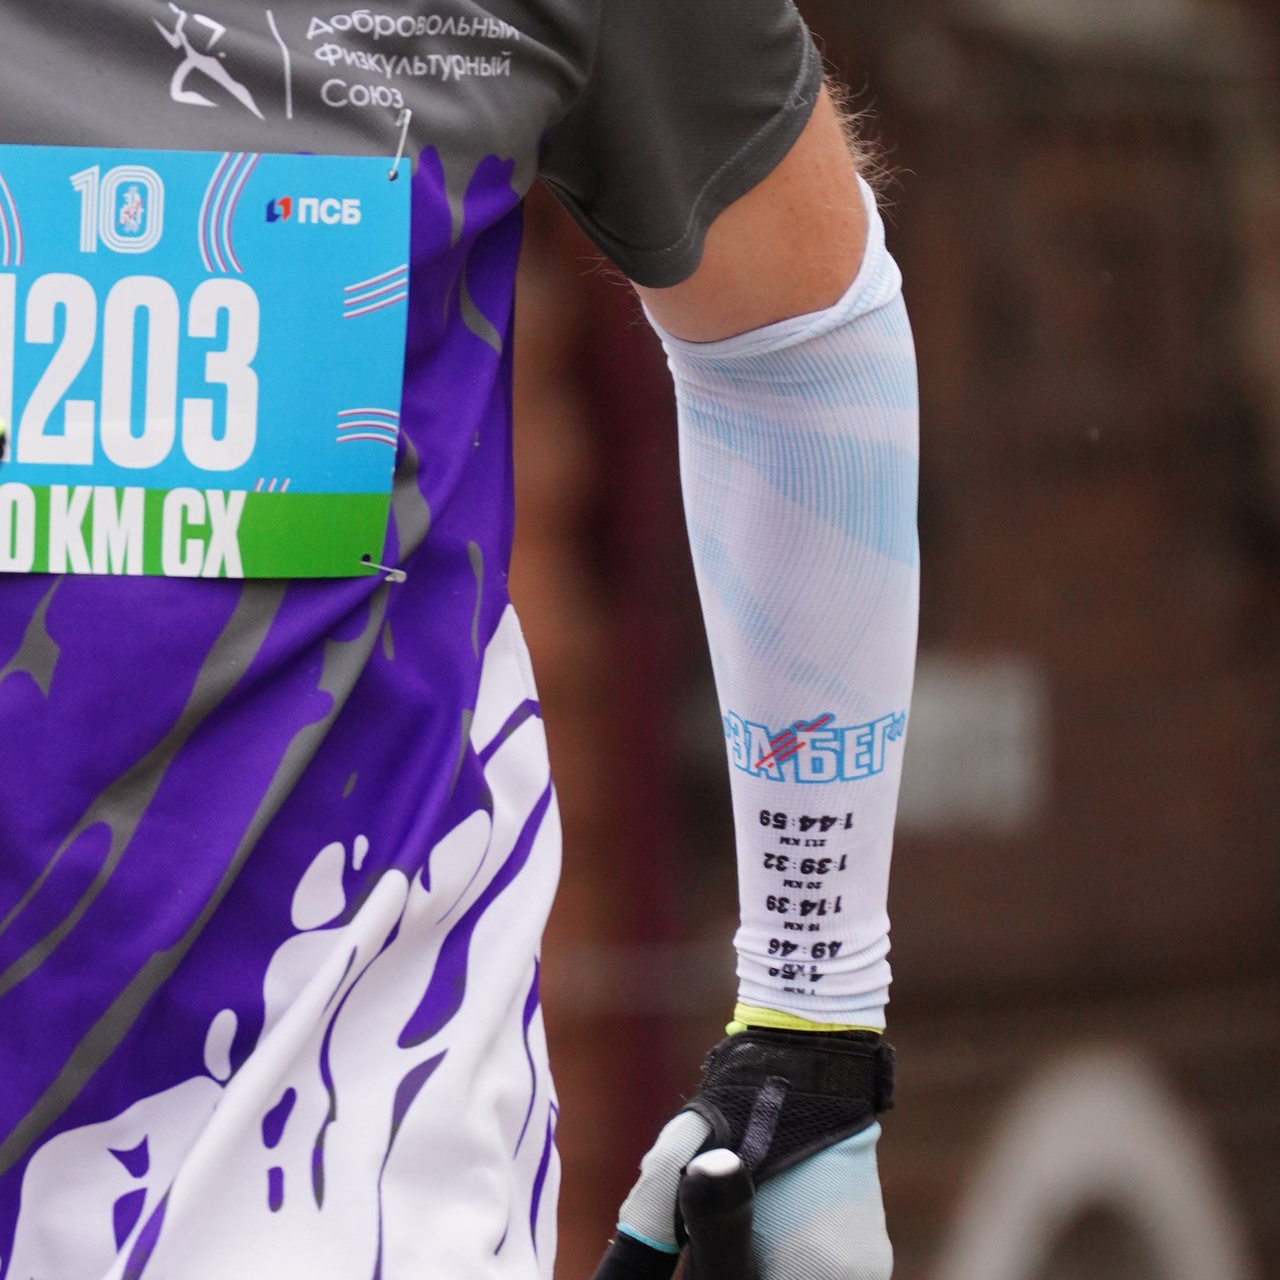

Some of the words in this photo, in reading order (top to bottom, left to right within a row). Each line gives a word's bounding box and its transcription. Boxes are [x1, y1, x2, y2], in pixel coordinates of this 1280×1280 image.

[313, 42, 512, 81] Физкультурный
[320, 78, 405, 109] Союз
[69, 164, 166, 255] 10
[297, 197, 362, 225] ПСБ
[48, 484, 145, 575] КМ
[161, 487, 247, 579] СХ
